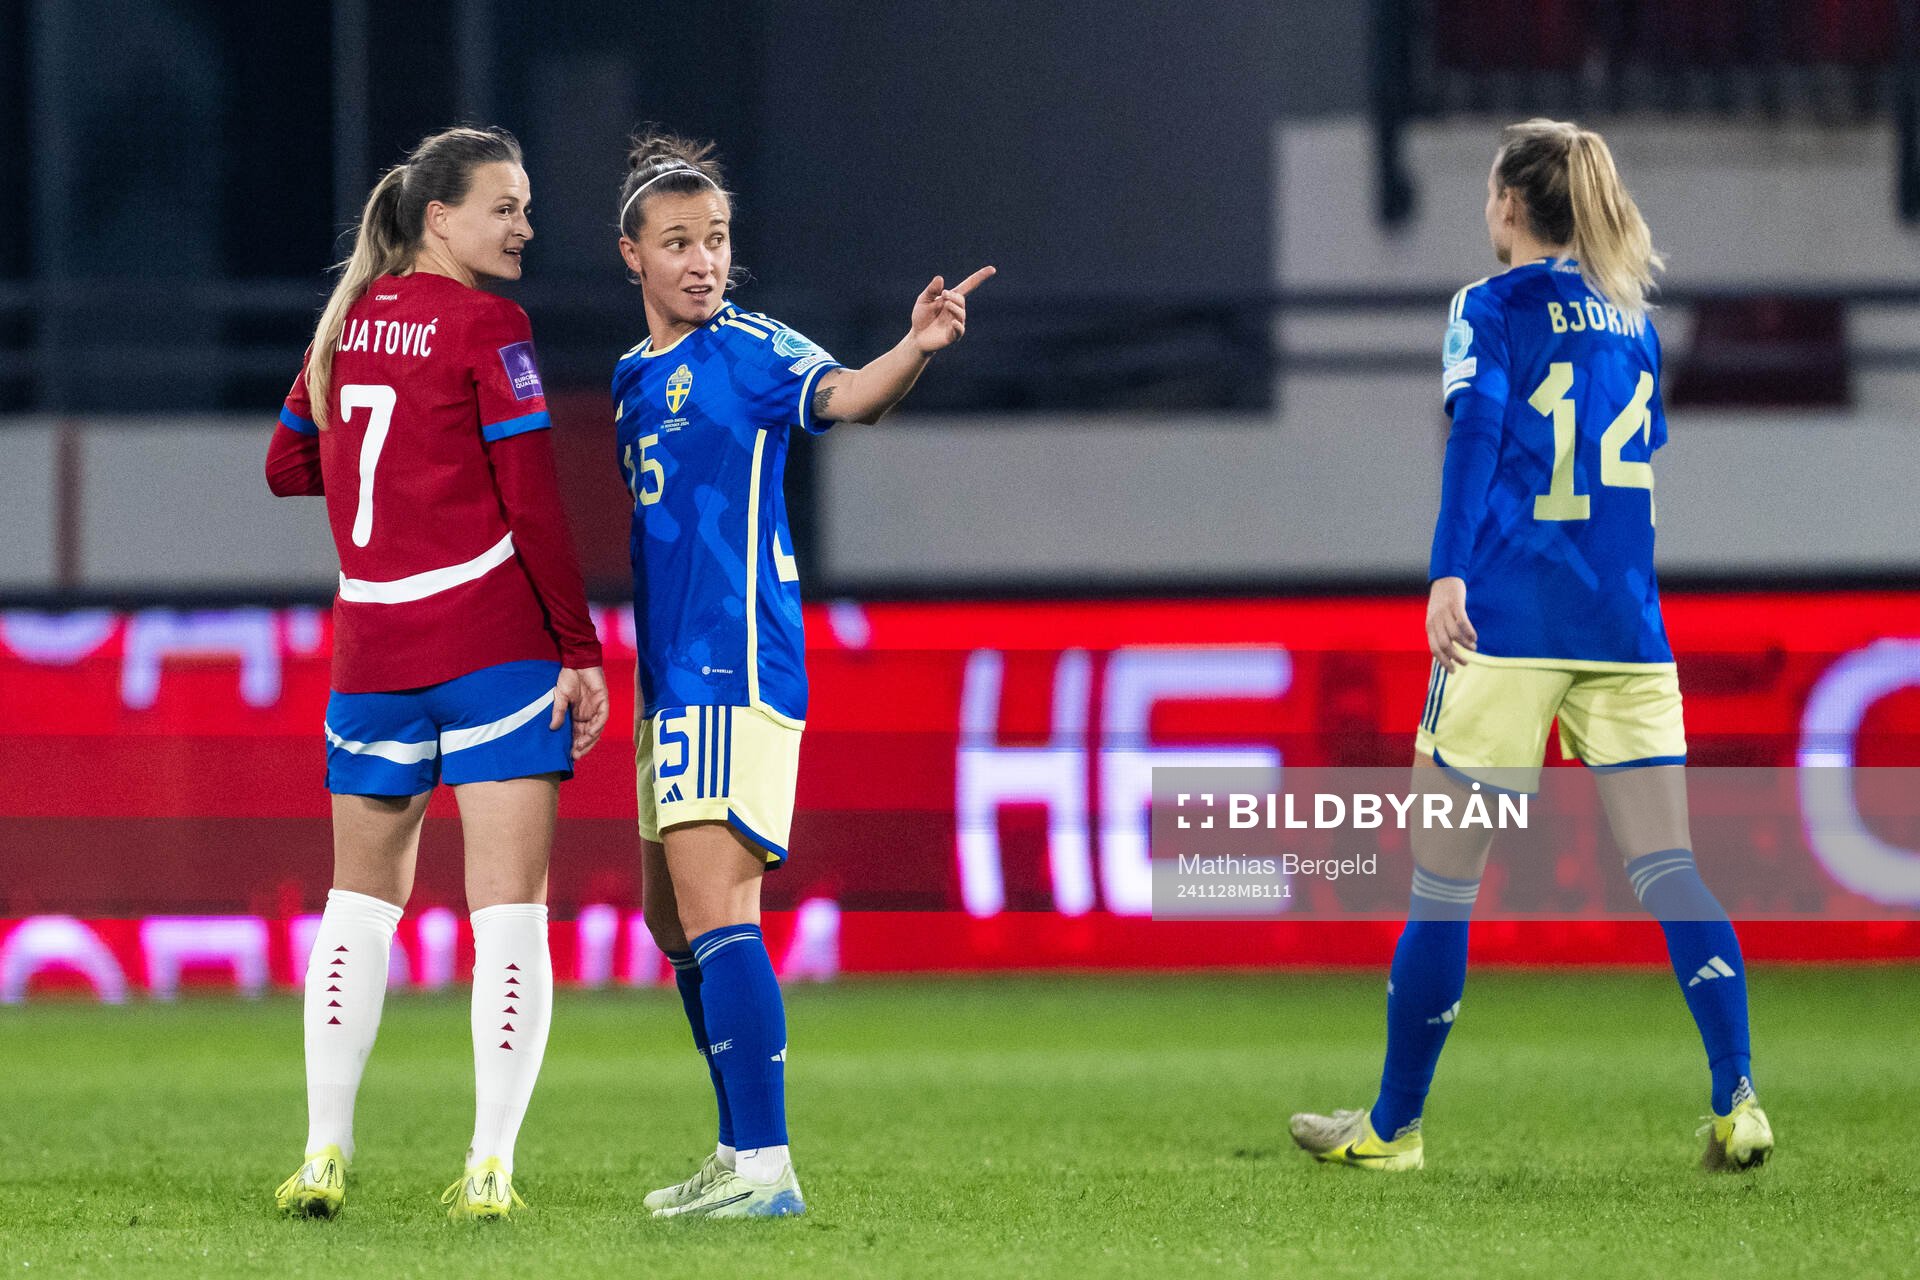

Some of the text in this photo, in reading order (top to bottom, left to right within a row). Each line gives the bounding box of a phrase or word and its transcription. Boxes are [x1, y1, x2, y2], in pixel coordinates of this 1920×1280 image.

[340, 384, 397, 548] 7
[1528, 362, 1655, 522] 14
[653, 707, 690, 783] 5
